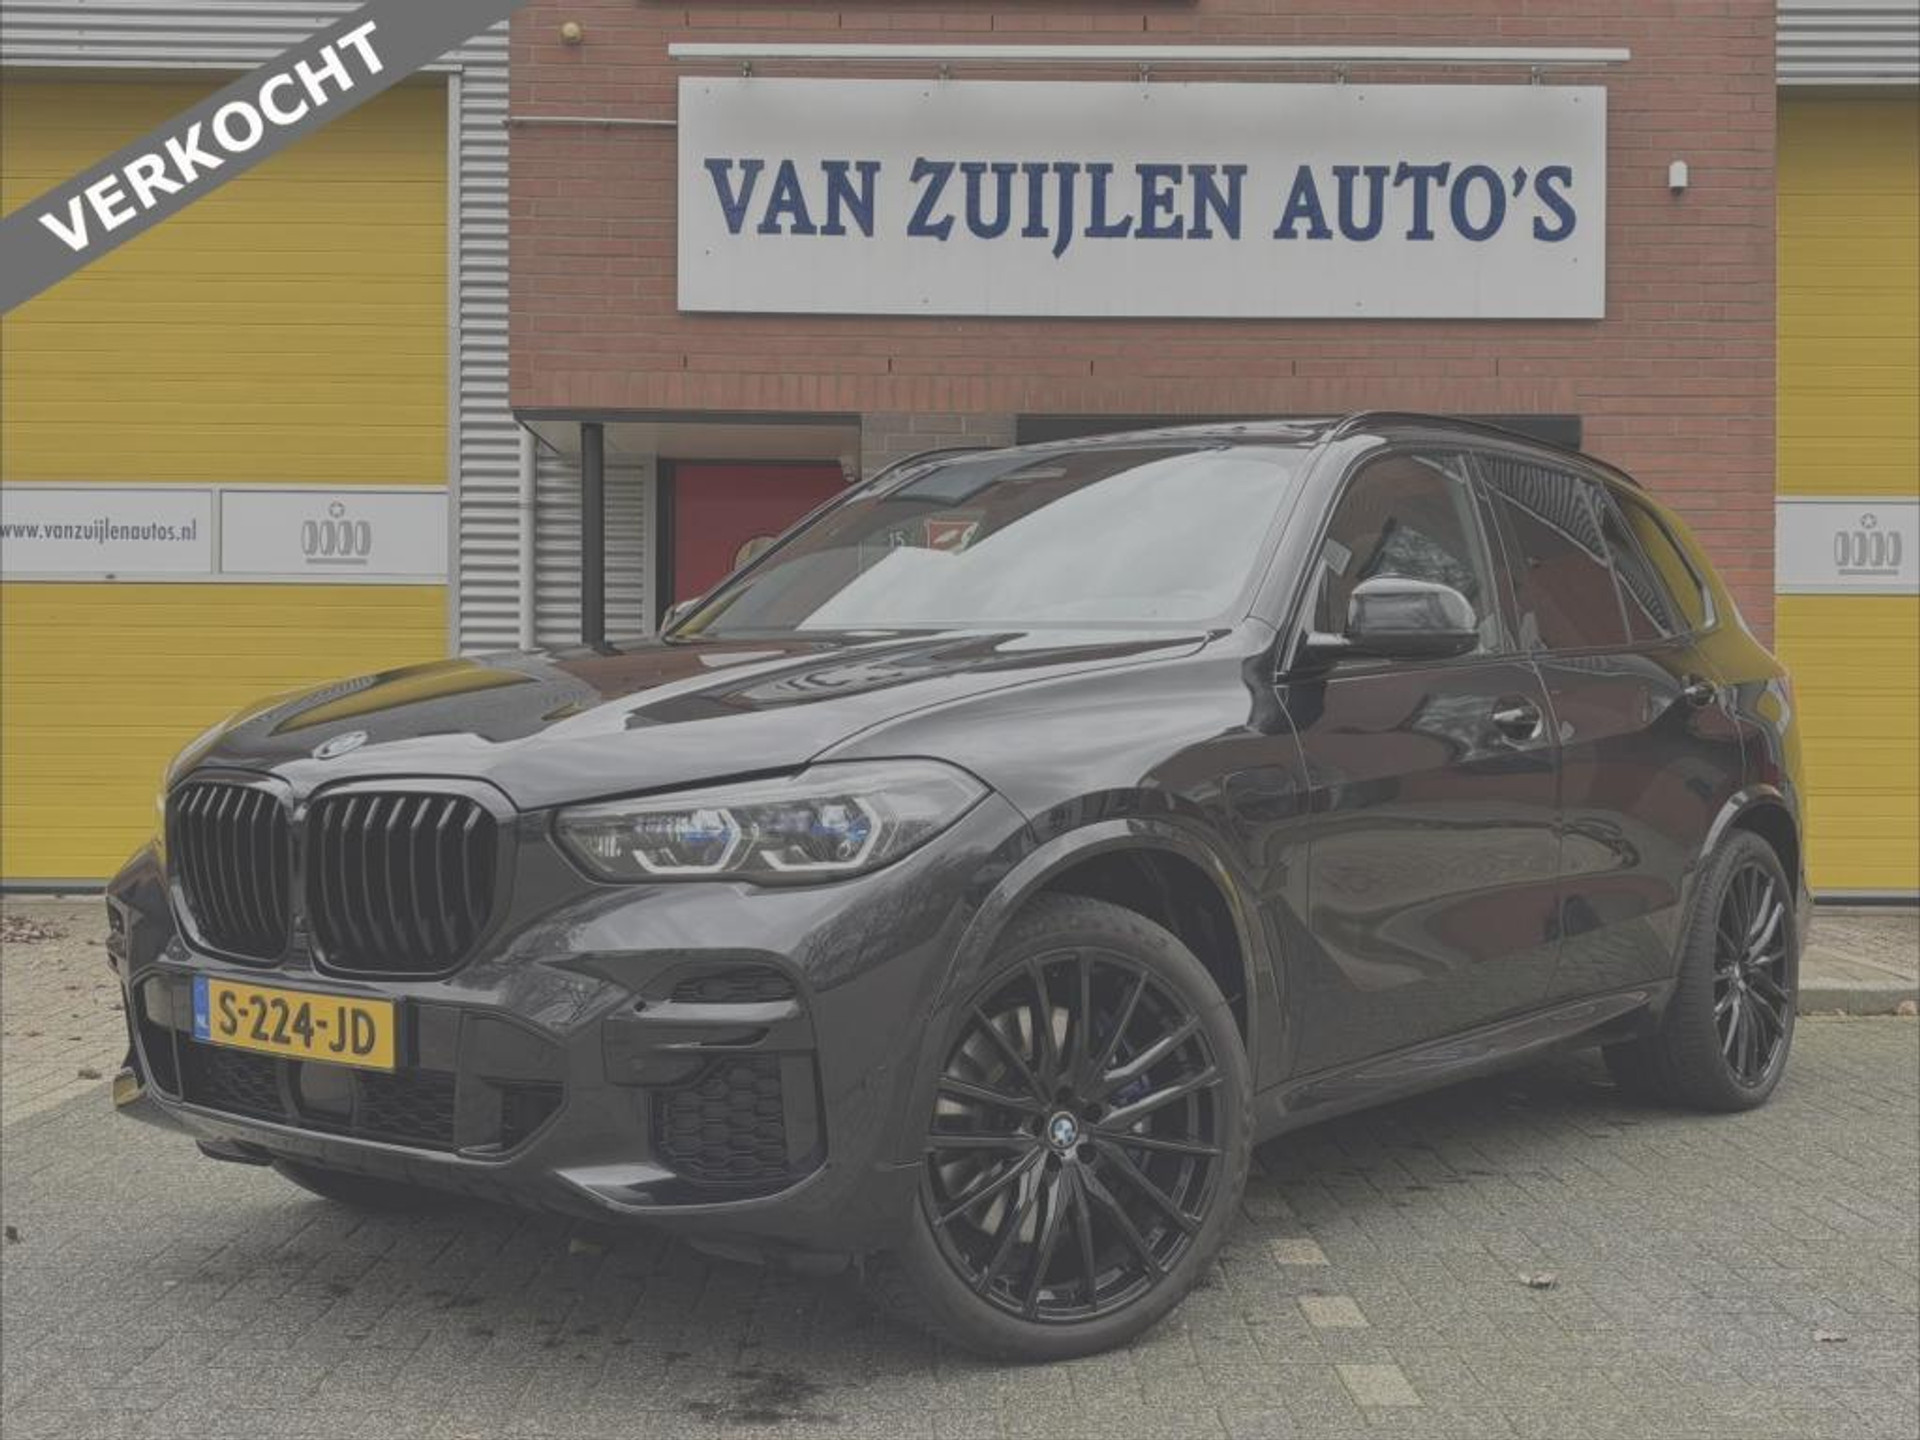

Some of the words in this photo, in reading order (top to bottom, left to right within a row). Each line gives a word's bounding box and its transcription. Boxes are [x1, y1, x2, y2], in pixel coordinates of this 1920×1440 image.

[704, 157, 881, 236] VAN
[907, 157, 1247, 260] ZUIJLEN
[1273, 161, 1577, 243] AUTO'S
[0, 517, 197, 545] www.vanzuijlenautos.nl
[218, 990, 377, 1055] S-224-JD
